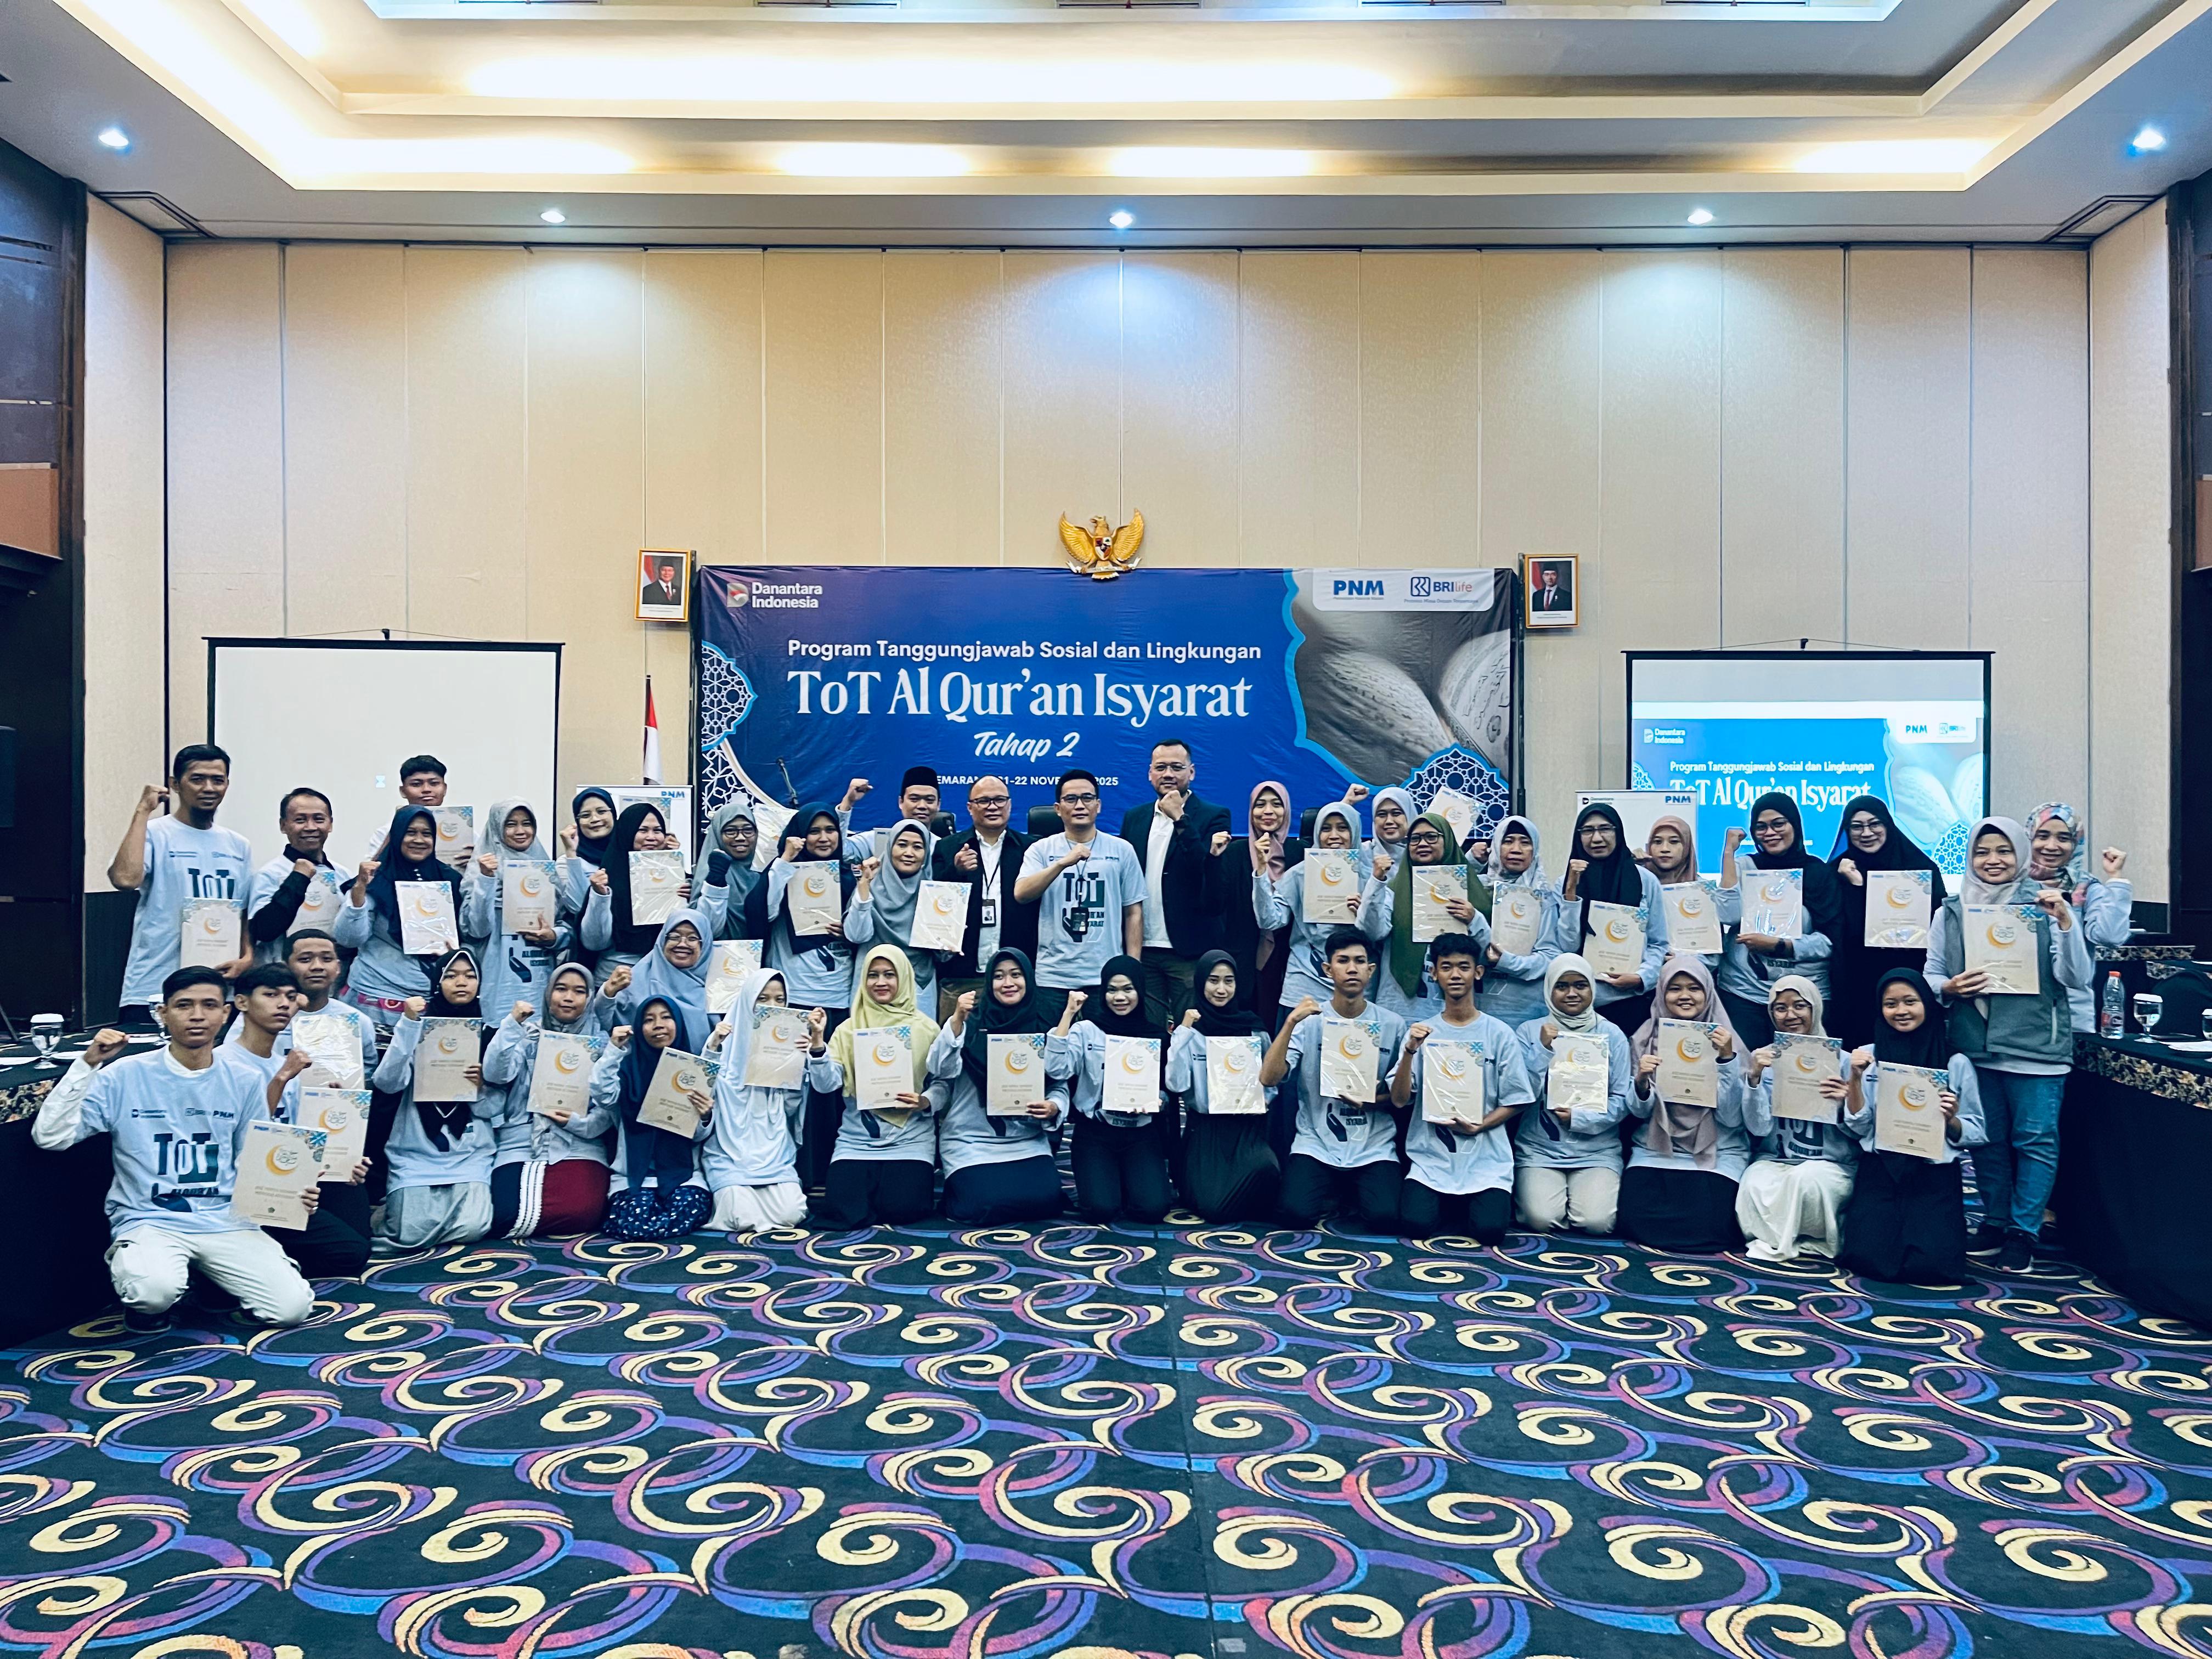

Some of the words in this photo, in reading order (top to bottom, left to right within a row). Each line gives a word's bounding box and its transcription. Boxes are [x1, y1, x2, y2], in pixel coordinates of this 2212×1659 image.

[752, 582, 822, 595] Danantara
[1333, 580, 1384, 595] PNM
[752, 596, 819, 608] Indonesia
[788, 640, 871, 661] Program
[877, 640, 1034, 662] Tanggungjawab
[1040, 641, 1097, 658] Sosial
[1103, 641, 1140, 658] dan
[1147, 642, 1261, 664] Lingkungan
[787, 670, 881, 714] ToT
[887, 666, 931, 714] Al
[939, 668, 1084, 723] Qur'an
[1093, 673, 1252, 727] Isyarat
[1905, 725, 1927, 733] PNM
[974, 731, 1052, 763] Tahap
[1056, 732, 1080, 757] 2
[1670, 760, 1707, 774] Program
[1707, 761, 1776, 774] Tanggungjawab
[1778, 760, 1803, 771] Sosial
[1804, 760, 1822, 771] dan
[1824, 760, 1875, 774] Lingkungan
[1712, 776, 1732, 805] Al
[1801, 779, 1871, 812] Isyarat
